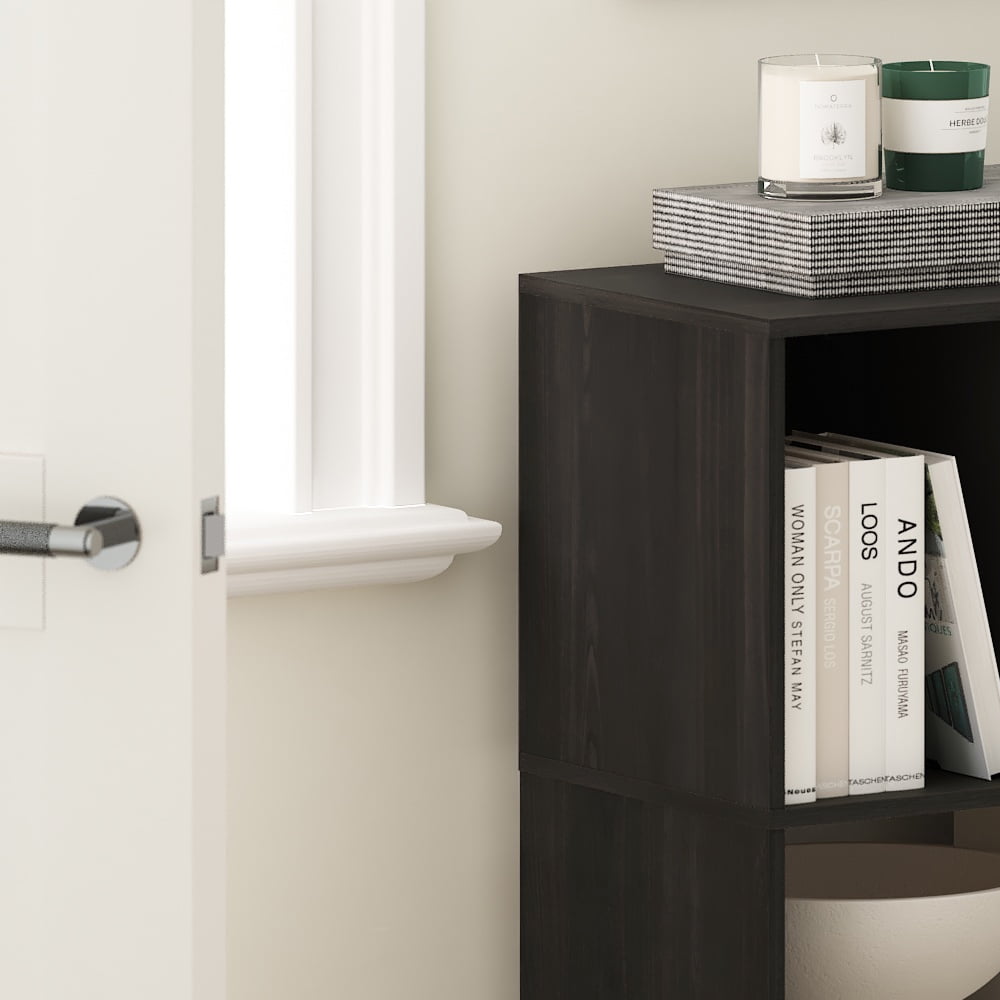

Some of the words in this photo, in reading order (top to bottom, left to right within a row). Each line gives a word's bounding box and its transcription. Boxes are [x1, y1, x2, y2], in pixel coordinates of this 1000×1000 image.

[949, 118, 975, 127] HERBE
[791, 503, 805, 567] WOMAN
[823, 504, 842, 592] SCARPA
[860, 502, 878, 561] LOOS
[897, 517, 917, 599] ANDO
[791, 571, 805, 615] ONLY
[860, 583, 872, 631] AUGUST
[823, 597, 837, 641] SERGIO
[791, 620, 803, 676] STEFAN
[823, 645, 837, 669] LOS
[860, 634, 872, 686] SARNITZ
[897, 630, 908, 664] MASAO
[791, 682, 803, 711] MAY
[897, 668, 909, 719] FURUYAMA
[848, 776, 885, 785] TASCHEN
[885, 772, 925, 782] TASCHEN
